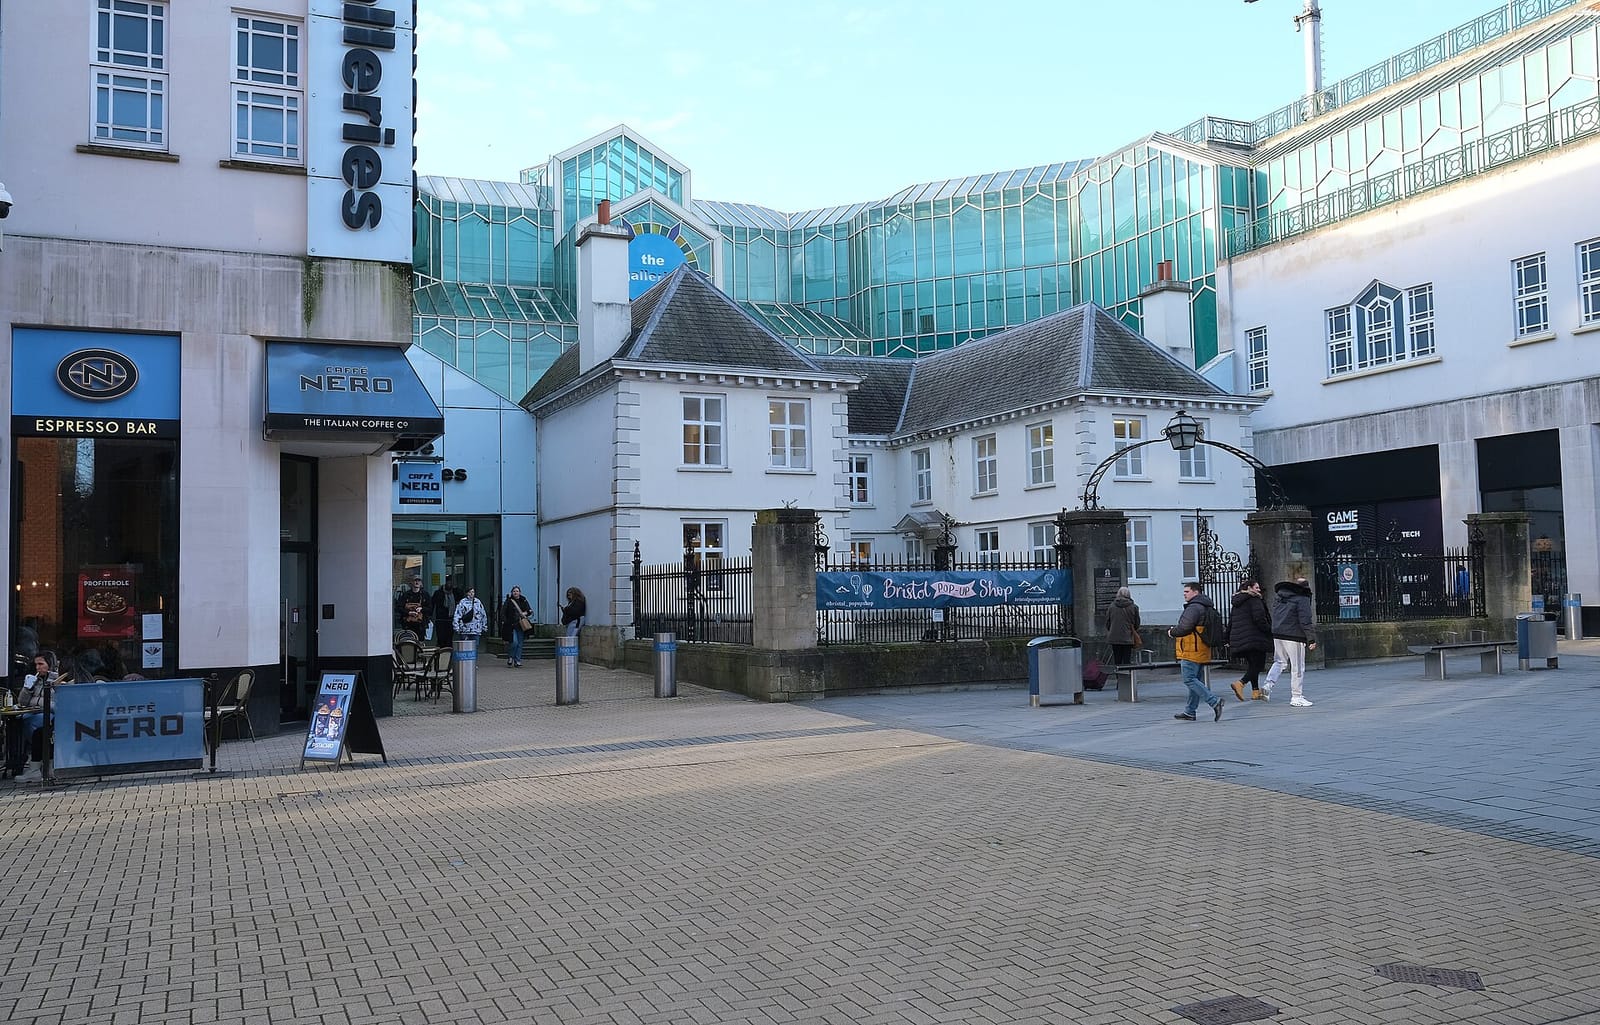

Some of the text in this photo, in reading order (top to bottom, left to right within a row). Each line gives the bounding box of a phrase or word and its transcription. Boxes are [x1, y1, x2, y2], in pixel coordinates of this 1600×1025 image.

[341, 0, 396, 231] lleries
[641, 254, 665, 266] the
[299, 375, 393, 393] NERO
[36, 419, 157, 434] ESPRESSO BAR
[304, 418, 321, 426] THE
[323, 419, 359, 428] ITALIAN
[361, 420, 394, 429] COFFEE
[401, 482, 440, 491] NERO
[1327, 510, 1358, 523] GAME
[883, 578, 1013, 602] Bristol POP-UP Shop
[74, 715, 184, 742] NERO
